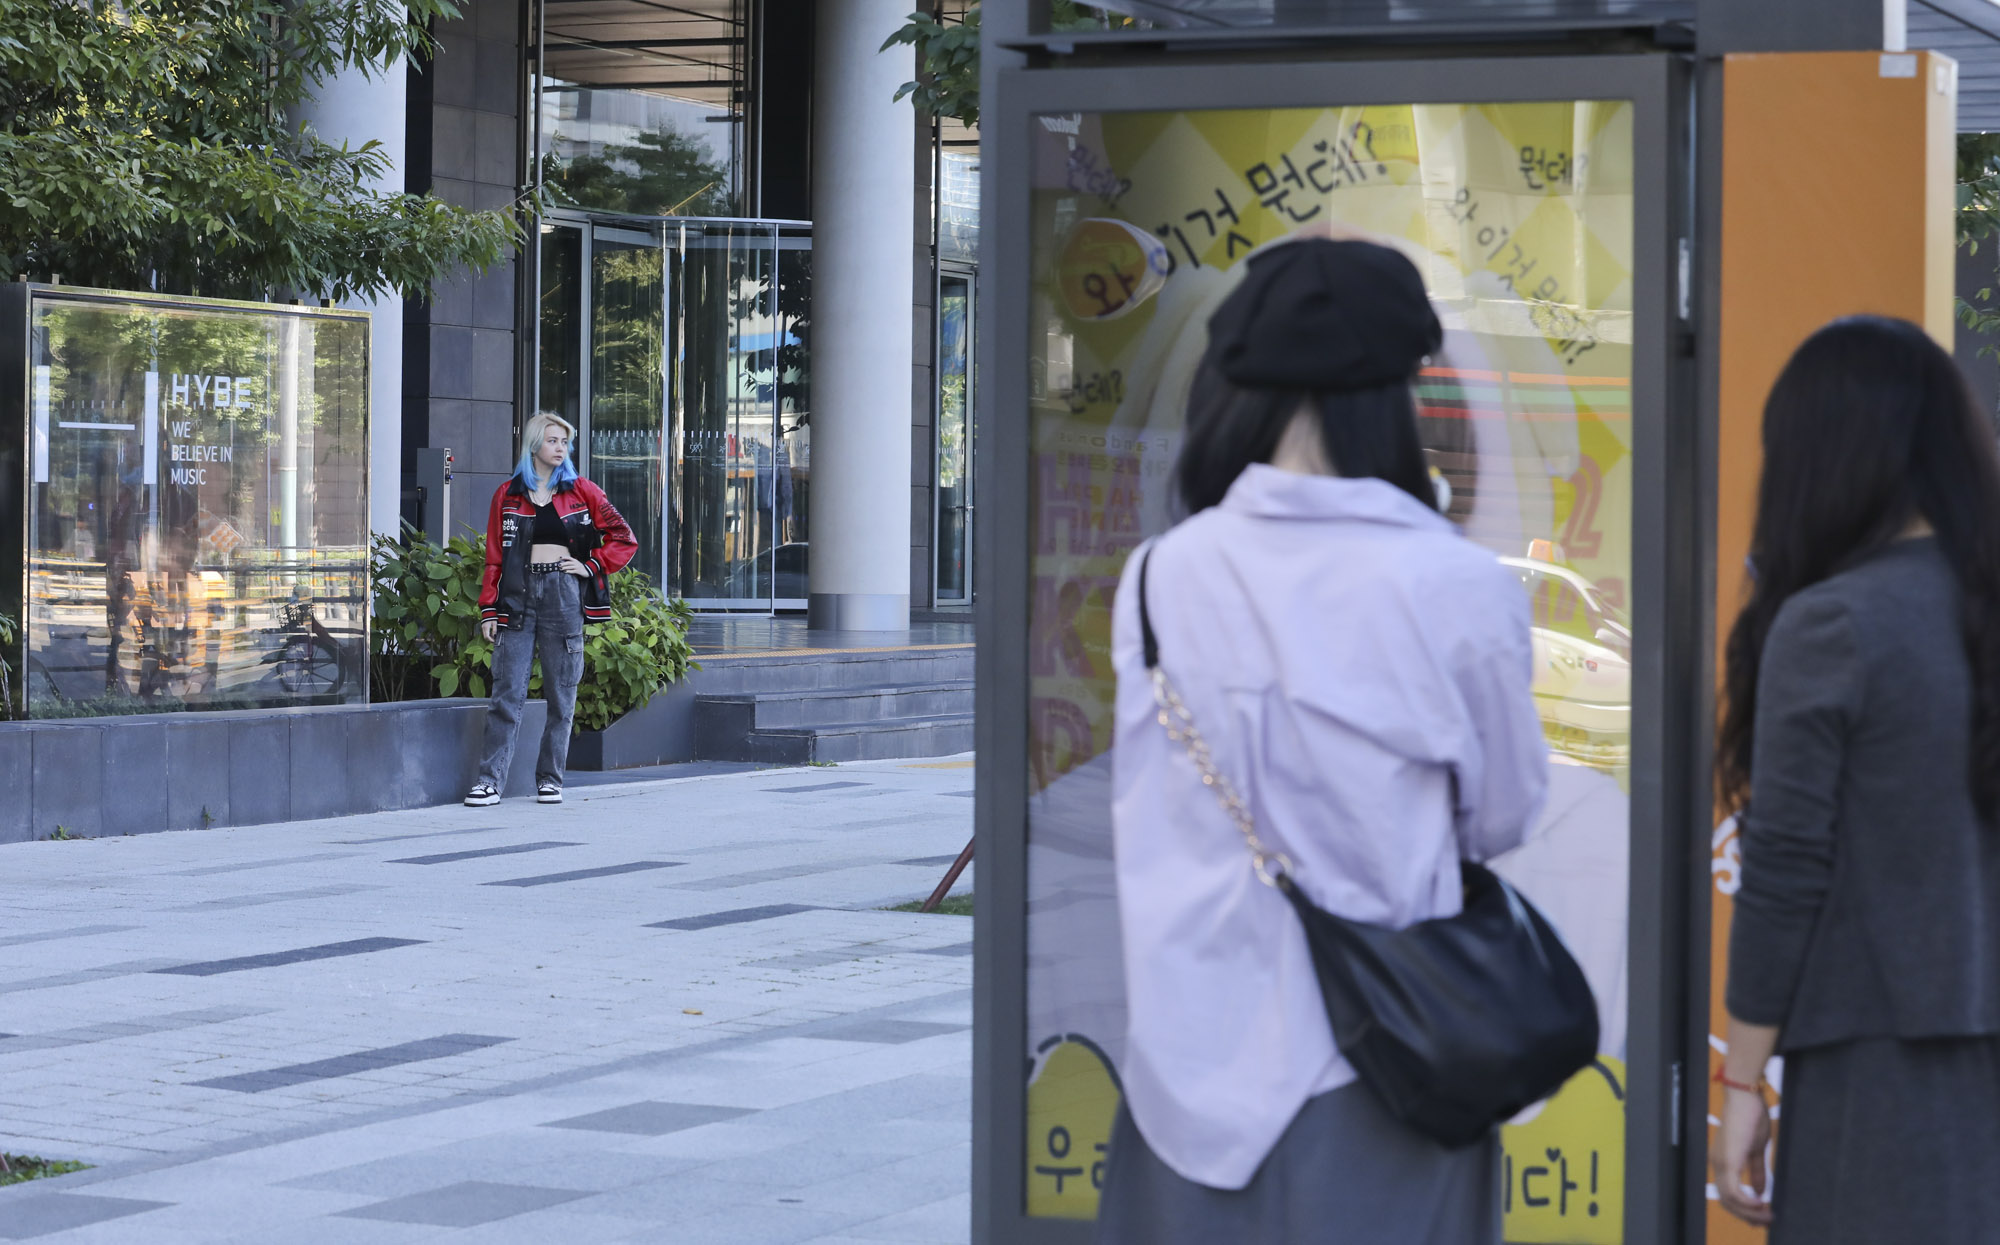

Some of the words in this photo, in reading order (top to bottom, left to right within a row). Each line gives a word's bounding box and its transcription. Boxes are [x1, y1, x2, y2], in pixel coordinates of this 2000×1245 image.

[1245, 117, 1390, 224] 뭔데?
[172, 373, 252, 408] HYBE
[172, 421, 191, 438] WE
[171, 444, 218, 462] BELIEVE
[220, 446, 232, 462] IN
[171, 468, 207, 485] MUSIC
[1503, 1147, 1601, 1218] 다!
